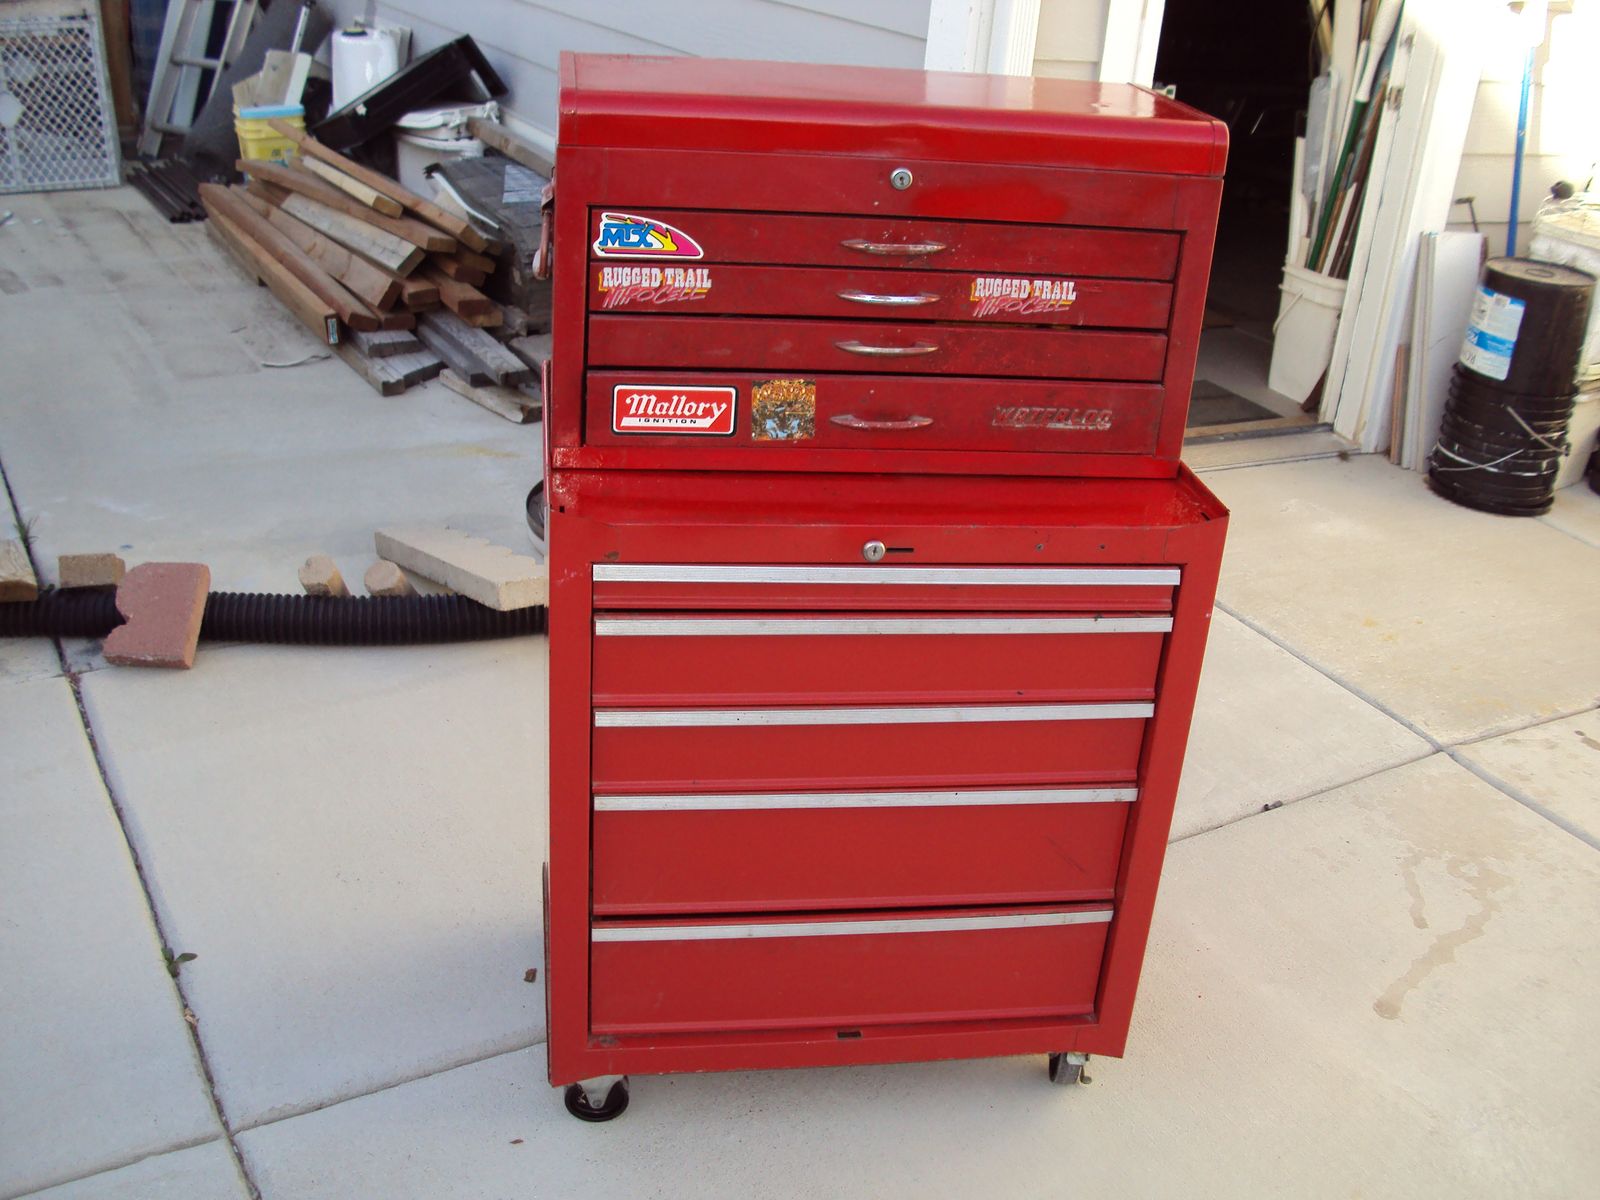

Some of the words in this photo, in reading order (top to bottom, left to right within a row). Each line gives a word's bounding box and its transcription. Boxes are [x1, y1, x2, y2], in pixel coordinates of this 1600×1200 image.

[598, 222, 656, 248] MTX
[602, 266, 663, 288] RUGGED
[664, 267, 713, 289] TRAIL
[974, 277, 1031, 299] RUGGED
[1033, 279, 1077, 301] TRAIL
[625, 392, 728, 420] Mallory
[637, 417, 698, 425] IGNITION
